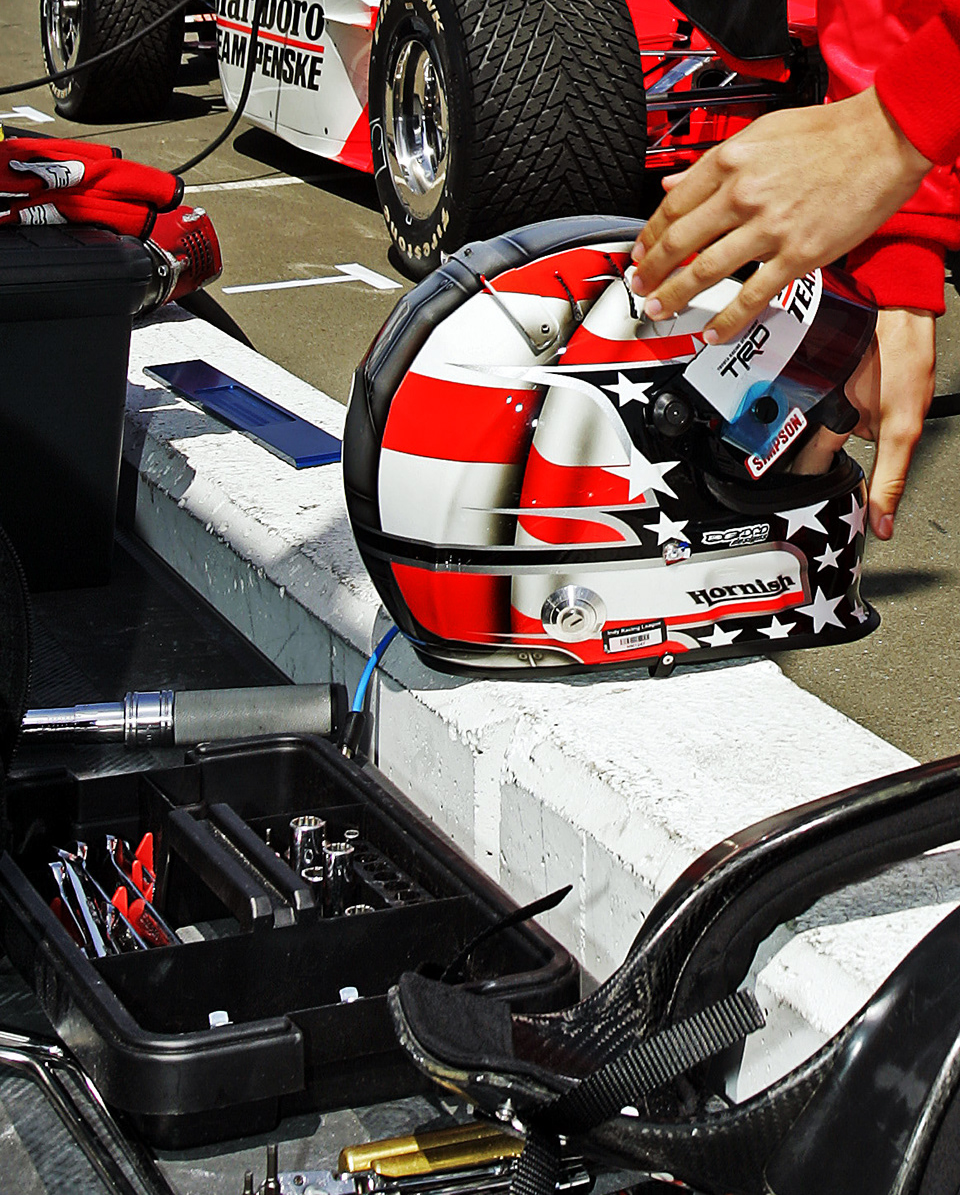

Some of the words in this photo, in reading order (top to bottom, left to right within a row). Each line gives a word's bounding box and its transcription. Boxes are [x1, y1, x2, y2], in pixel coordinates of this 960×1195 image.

[720, 323, 771, 378] TRD
[752, 414, 804, 471] SIMPSON
[686, 574, 796, 607] Hornish
